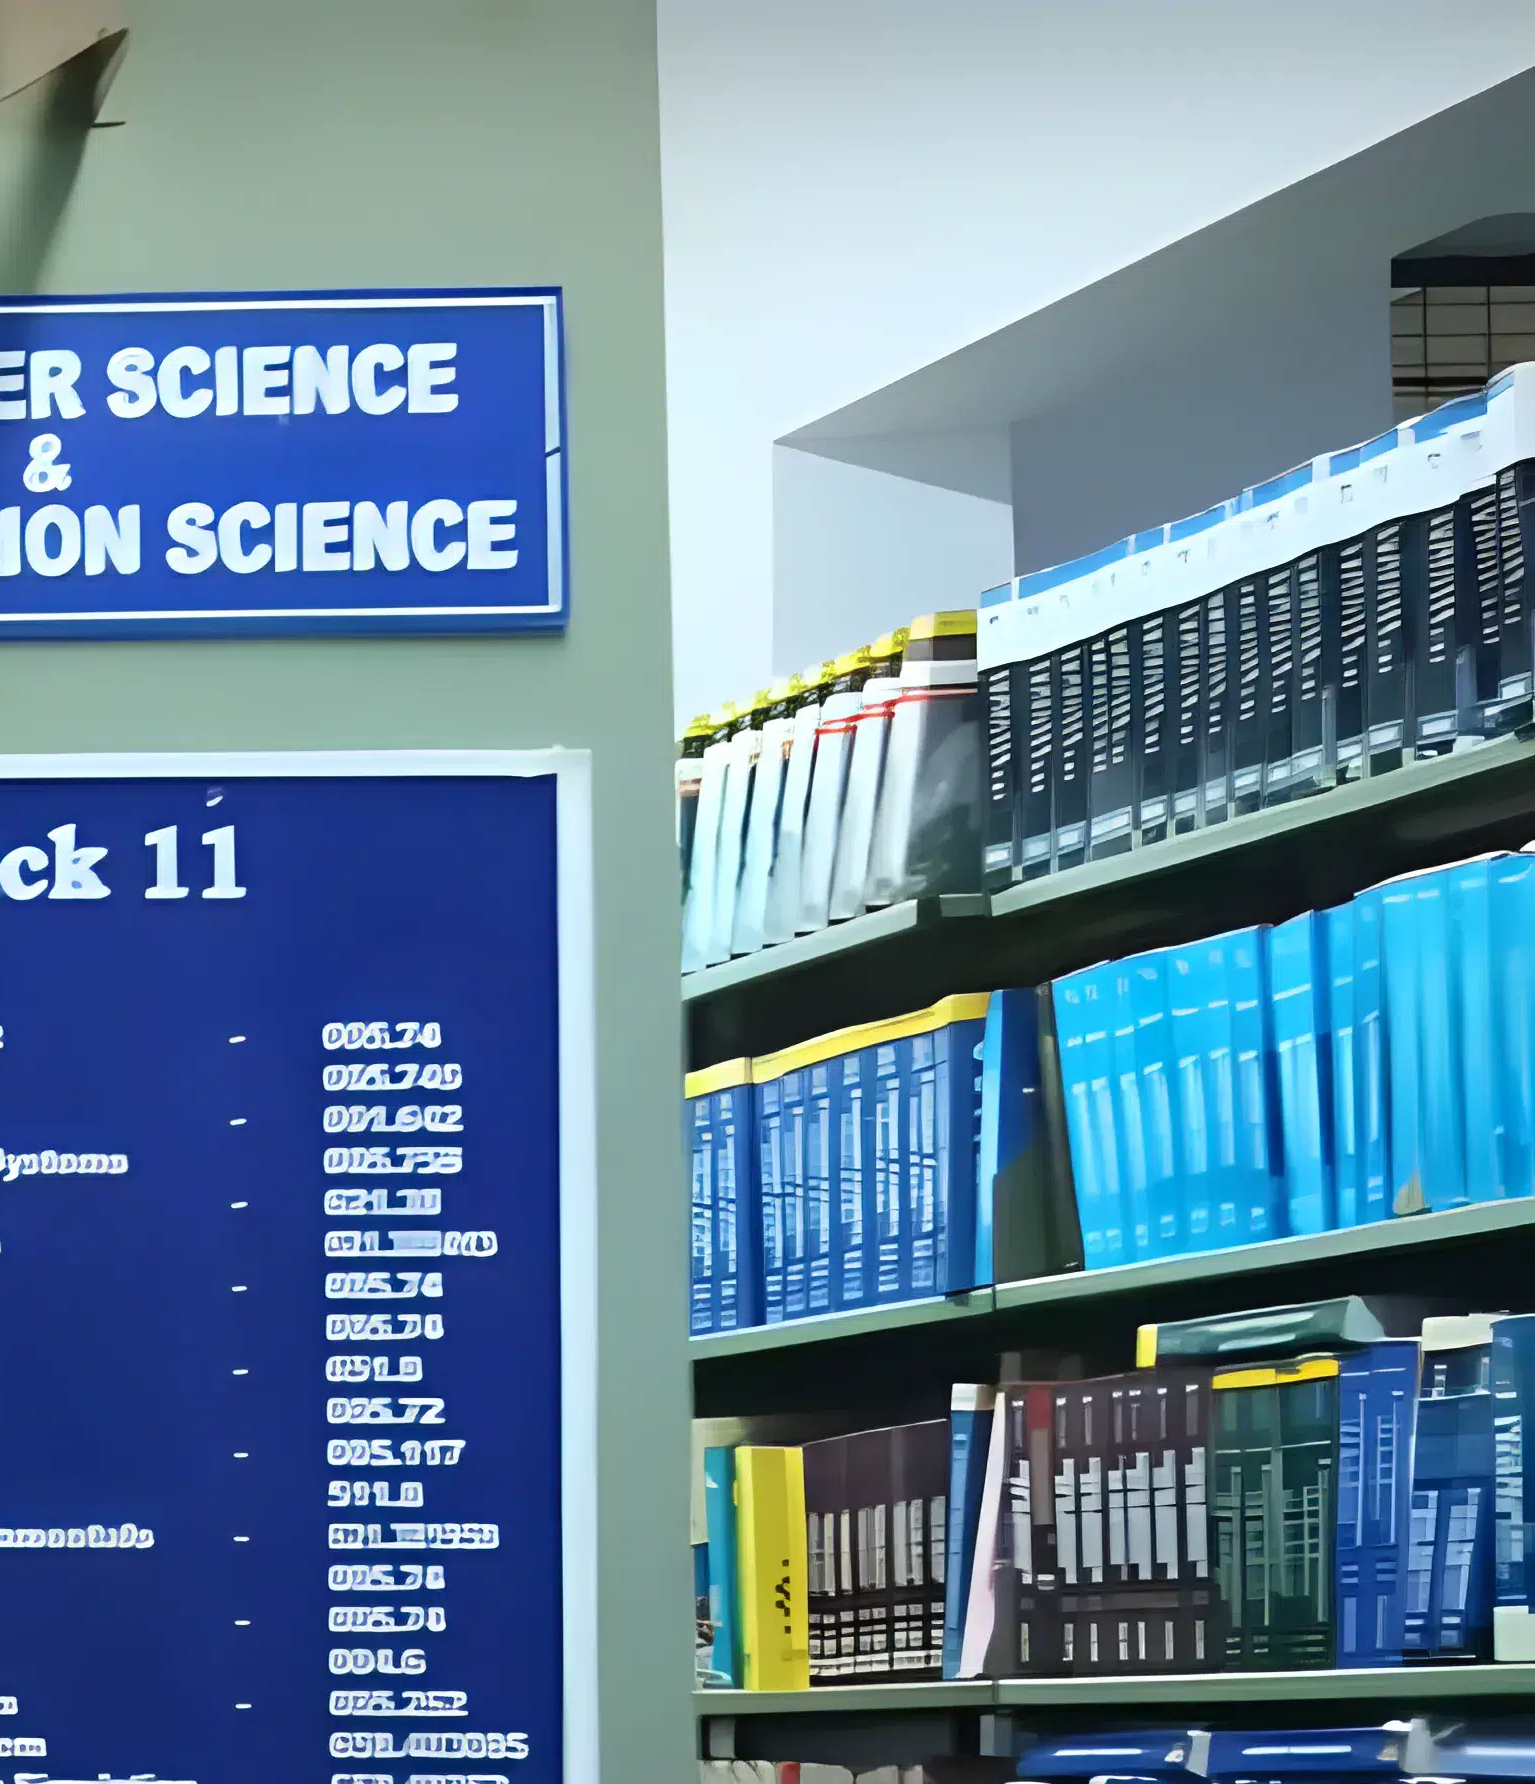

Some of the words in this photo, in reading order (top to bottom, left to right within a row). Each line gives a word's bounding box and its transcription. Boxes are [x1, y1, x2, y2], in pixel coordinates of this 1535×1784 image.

[106, 341, 460, 420] SCIENCE
[22, 432, 73, 494] &
[164, 498, 520, 576] SCIENCE
[143, 824, 248, 902] 11
